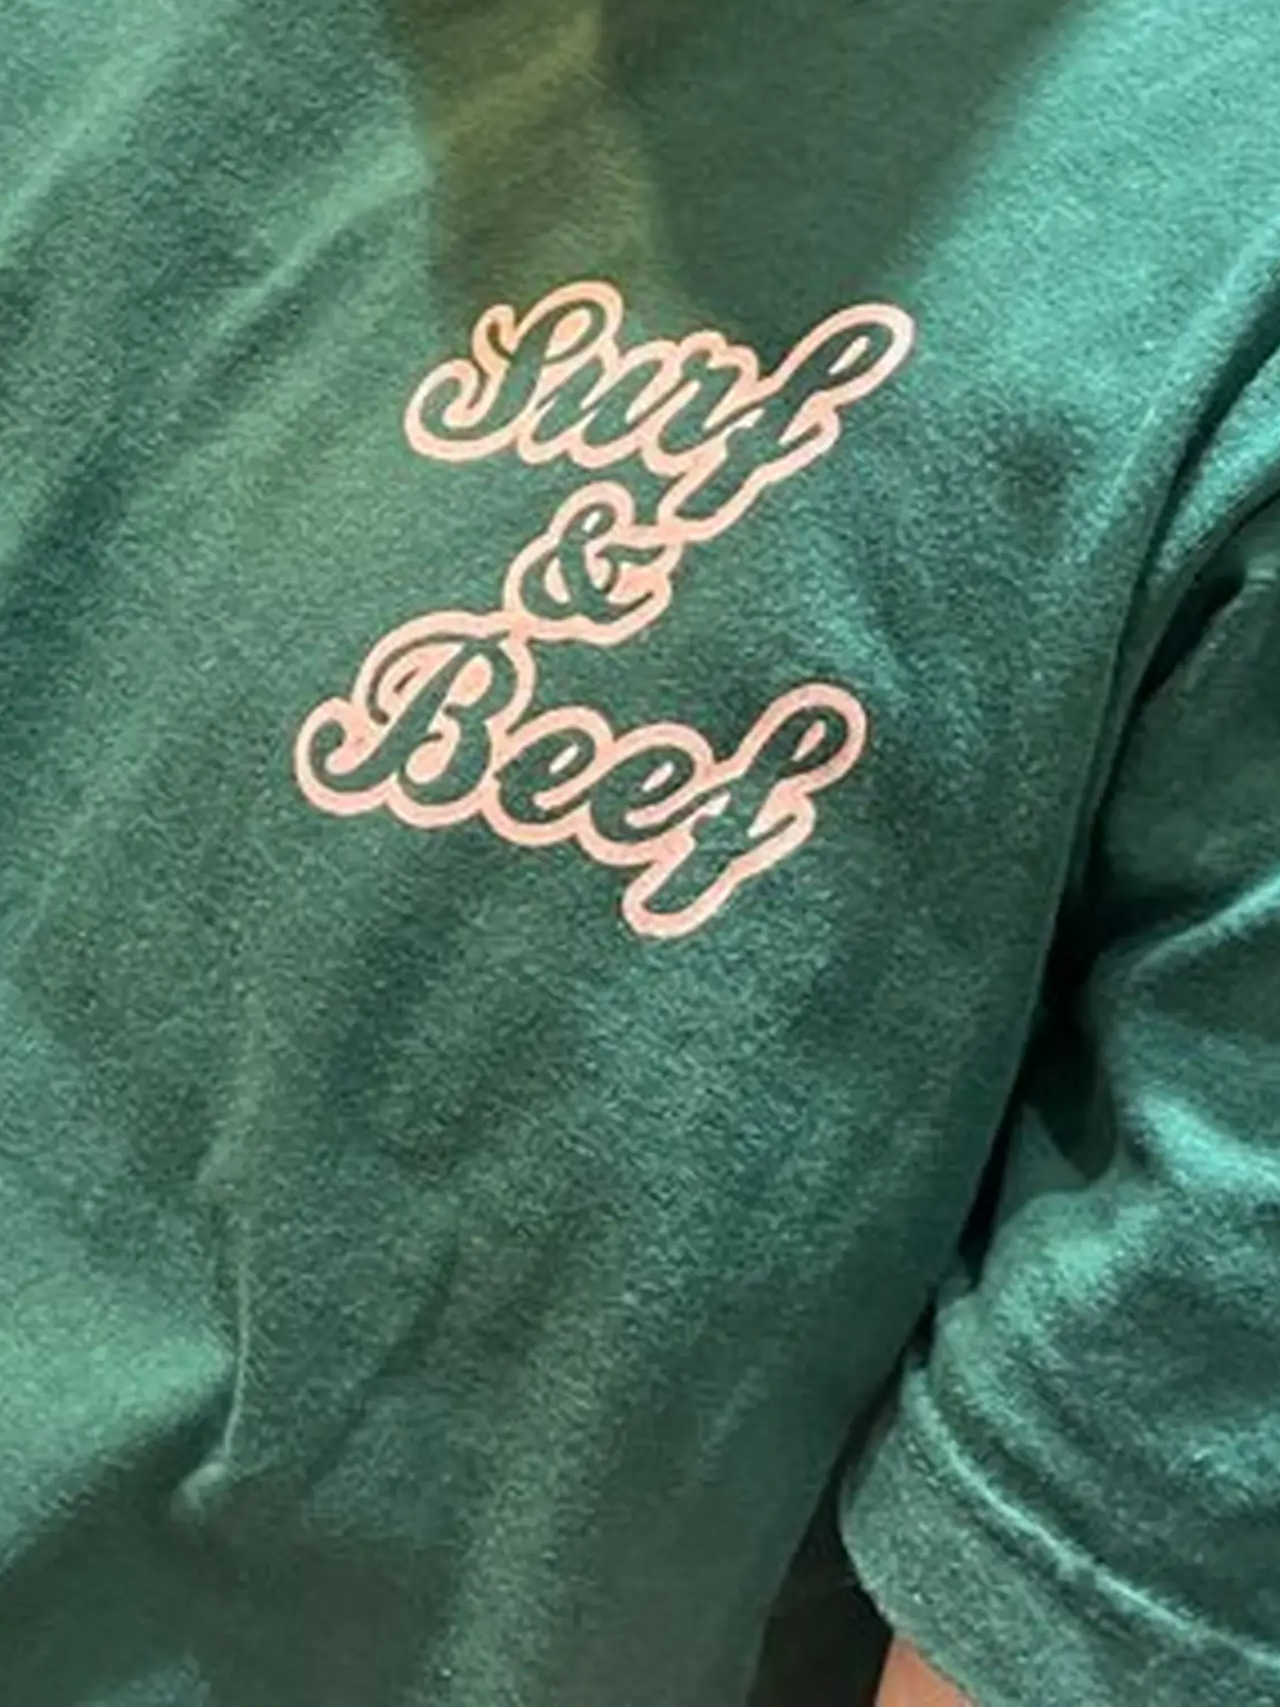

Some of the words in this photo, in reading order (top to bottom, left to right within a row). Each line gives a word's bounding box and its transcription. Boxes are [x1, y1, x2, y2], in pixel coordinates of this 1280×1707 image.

[404, 280, 914, 541] Surf
[504, 480, 681, 646] &
[295, 611, 867, 938] Beef
